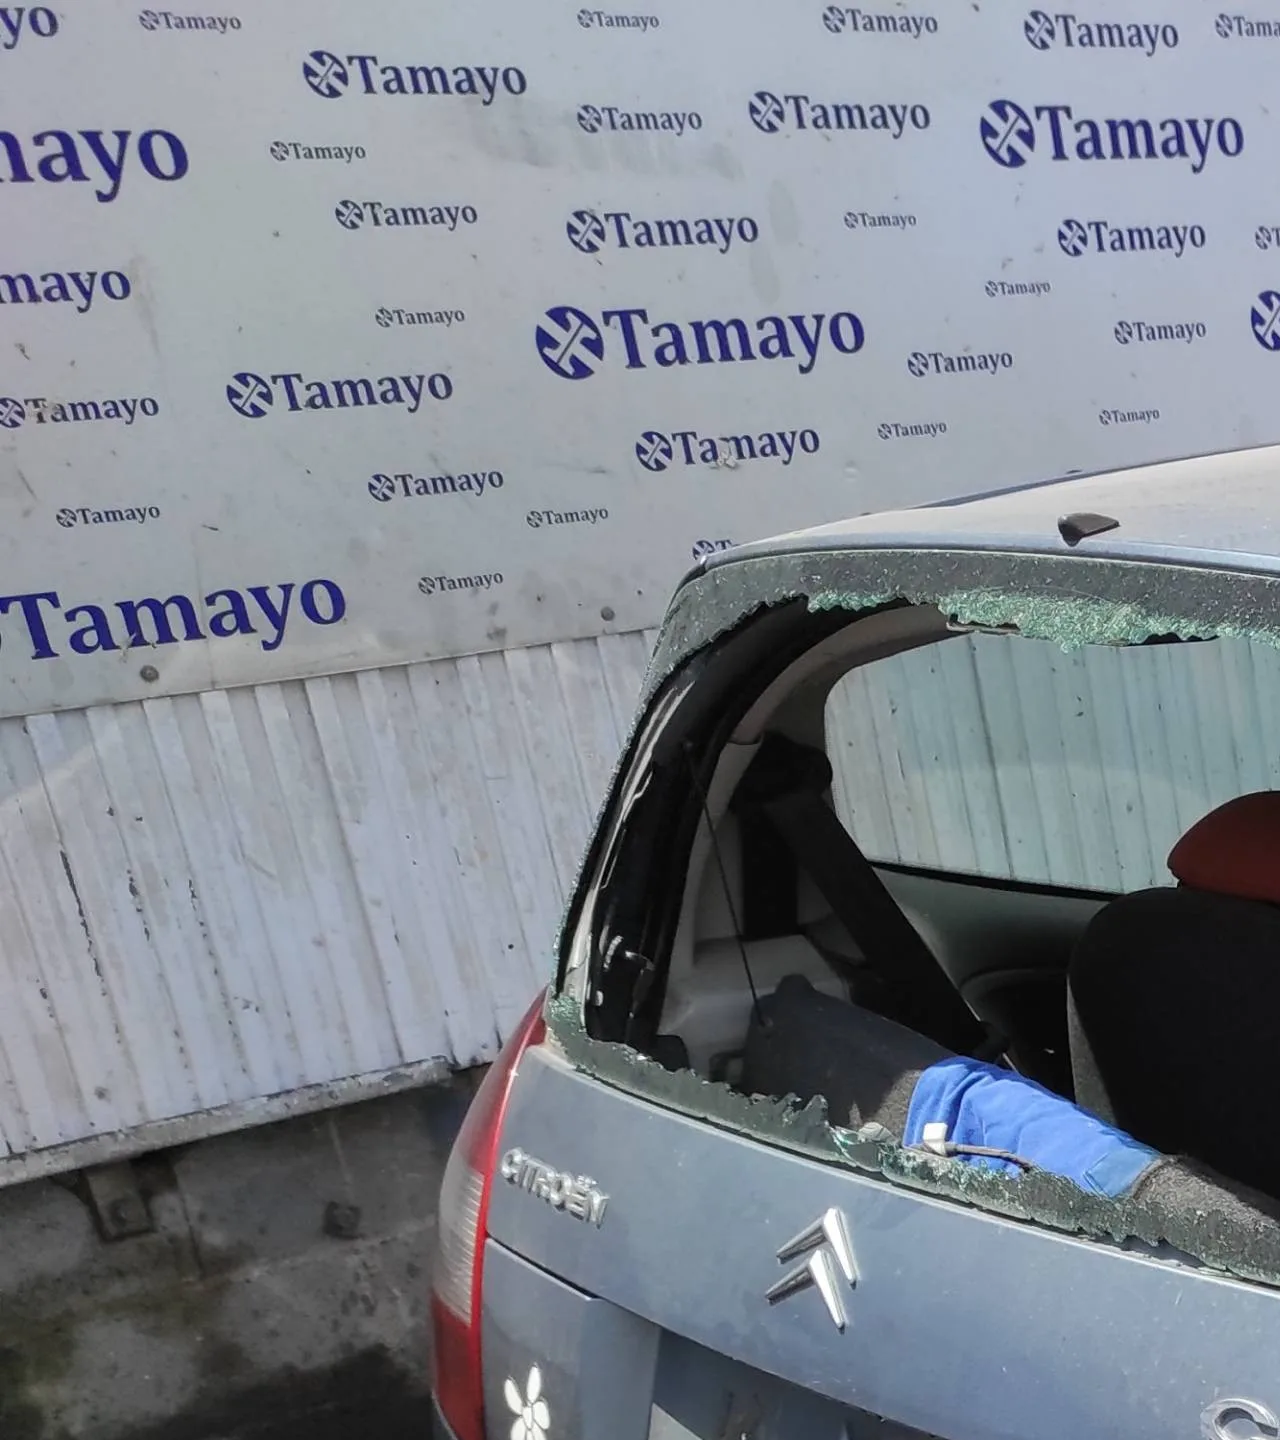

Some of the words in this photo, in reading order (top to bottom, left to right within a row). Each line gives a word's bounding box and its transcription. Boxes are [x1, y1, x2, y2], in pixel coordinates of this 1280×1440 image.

[161, 11, 242, 35] Tamayo
[592, 10, 660, 33] Tamayo
[844, 8, 938, 39] Tamayo
[1054, 14, 1179, 57] Tamayo
[344, 55, 527, 107] Tamayo
[601, 106, 703, 136] Tamayo
[783, 95, 931, 140] Tamayo
[289, 142, 366, 164] Tamayo
[1034, 105, 1244, 174] Tamayo
[0, 129, 189, 203] ayo
[362, 201, 478, 231] Tamayo
[857, 212, 917, 230] Tamayo
[603, 212, 759, 255] Tamayo
[1087, 221, 1206, 258] Tamayo
[0, 270, 131, 313] mayo
[998, 281, 1051, 296] Tamayo
[393, 308, 465, 328] Tamayo
[1134, 321, 1207, 344] Tamayo
[601, 308, 865, 375] Tamayo
[927, 352, 1013, 375] Tamayo
[269, 373, 453, 414] Tamayo
[23, 396, 160, 426] Tamayo
[1110, 409, 1160, 424] Tamayo
[891, 422, 947, 438] Tamayo
[391, 470, 504, 497] Tamayo
[75, 506, 161, 525] Tamayo
[541, 508, 609, 525] Tamayo
[431, 572, 504, 592] Tamayo
[0, 577, 347, 661] Tamayo
[501, 1147, 610, 1230] CITROËN
